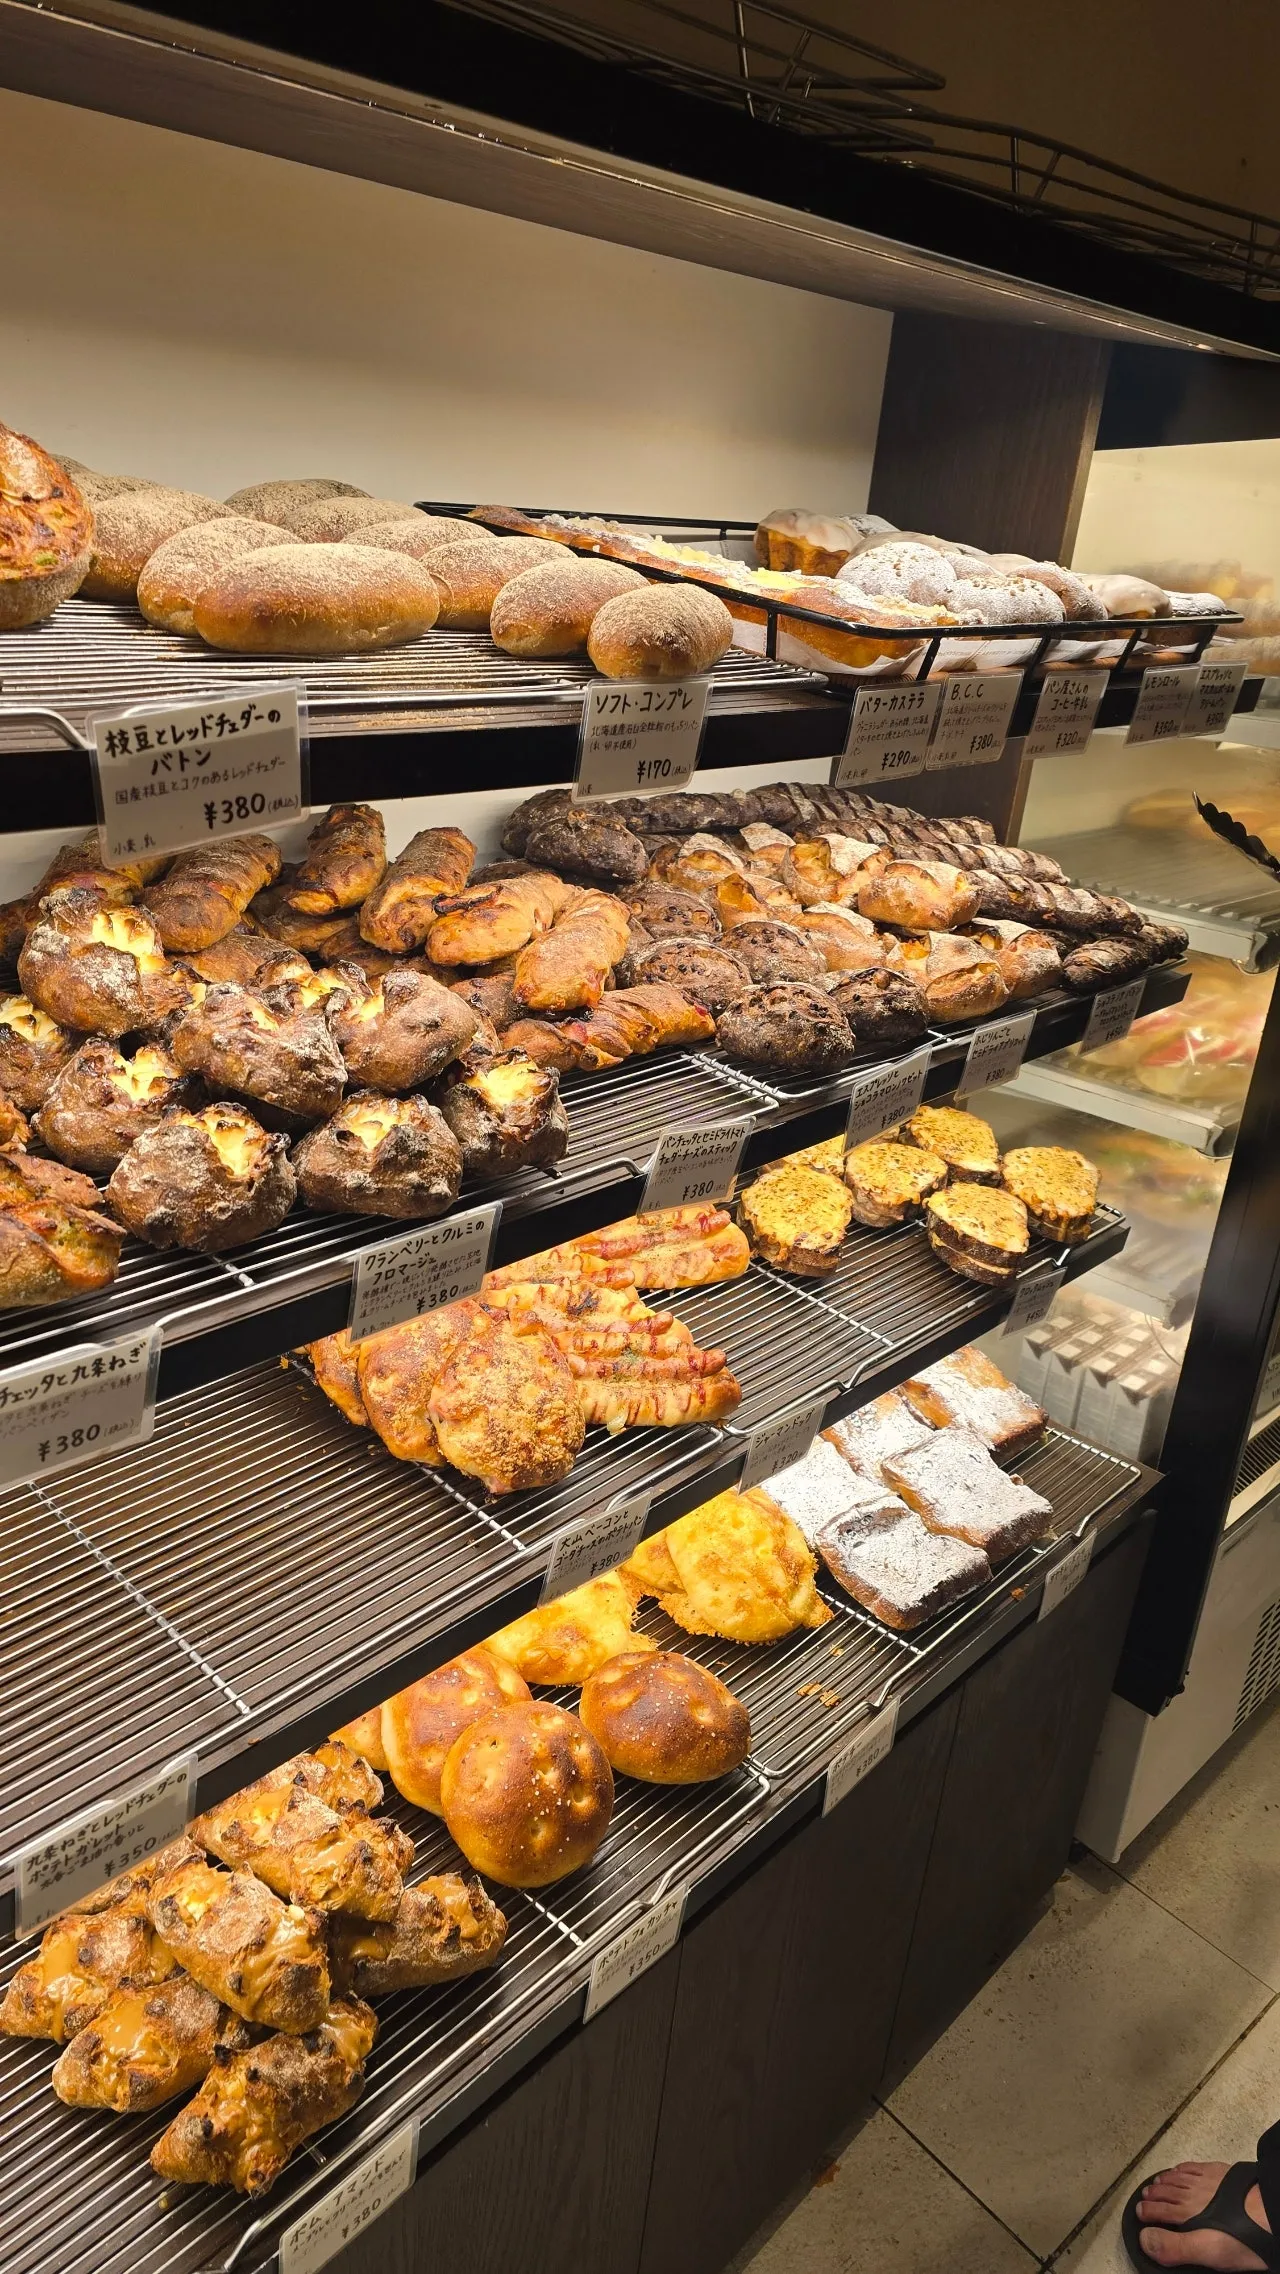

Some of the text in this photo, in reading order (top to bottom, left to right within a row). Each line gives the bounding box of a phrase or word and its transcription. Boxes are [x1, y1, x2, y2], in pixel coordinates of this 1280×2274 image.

[1045, 679, 1089, 695] パン屋さんの
[1145, 675, 1180, 691] レモンロール
[597, 688, 693, 714] ソフト・コンプレ
[860, 692, 925, 714] バターカステラ
[1051, 698, 1088, 711] コーヒー牛乳
[105, 704, 281, 757] 枝豆とレッドチェダーの
[970, 733, 993, 754] ¥380
[1056, 731, 1077, 748] ¥320
[152, 750, 211, 775] バトン
[637, 759, 671, 783] ¥170
[881, 751, 910, 770] ¥290
[115, 757, 285, 804] 国産枝豆とコクのあるレッドチェダー
[204, 793, 266, 829] ¥380
[856, 1070, 899, 1098] エスプレッソと
[881, 1106, 905, 1128] ¥380
[659, 1141, 737, 1165] チェダーチーズのスティック
[661, 1127, 745, 1150] パンチェッタとセミドライトマト
[683, 1180, 714, 1201] ¥380
[365, 1221, 485, 1271] クランベリーとクルミの
[373, 1252, 437, 1286] フロマージュ
[416, 1285, 459, 1314] ¥380
[0, 1341, 147, 1408] チェッタと九条ねぎ
[38, 1424, 100, 1462] ¥380
[554, 1516, 643, 1568] ゴーダチーズのポテトパン
[560, 1511, 628, 1551] 大山ベーコンと
[590, 1552, 620, 1576] ¥380
[27, 1772, 187, 1871] 九条ねぎとレッドチェダーの
[29, 1824, 124, 1884] ポテトガレット
[105, 1837, 156, 1877] ¥350
[598, 1901, 677, 1971] ポテトフォカッチャ
[629, 1944, 659, 1977] ¥350
[290, 2154, 385, 2246] ポム・アマンド
[341, 2198, 381, 2239] ¥380
